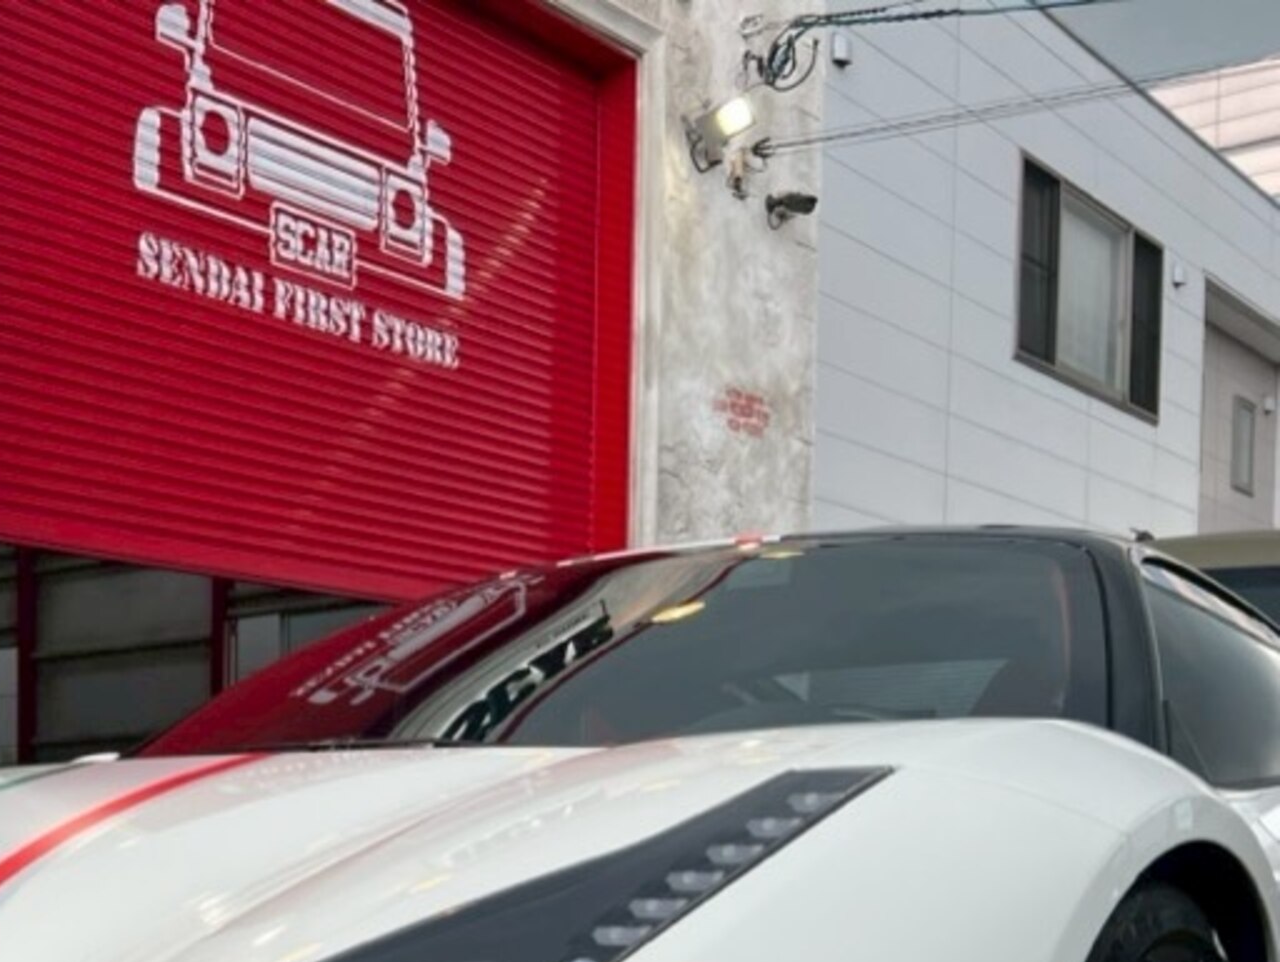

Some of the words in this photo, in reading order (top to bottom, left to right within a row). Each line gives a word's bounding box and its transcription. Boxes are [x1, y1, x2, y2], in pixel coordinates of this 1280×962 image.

[276, 212, 351, 276] SCAR
[137, 230, 264, 313] SENDAI
[273, 276, 366, 343] FIRST
[372, 309, 460, 369] STORE
